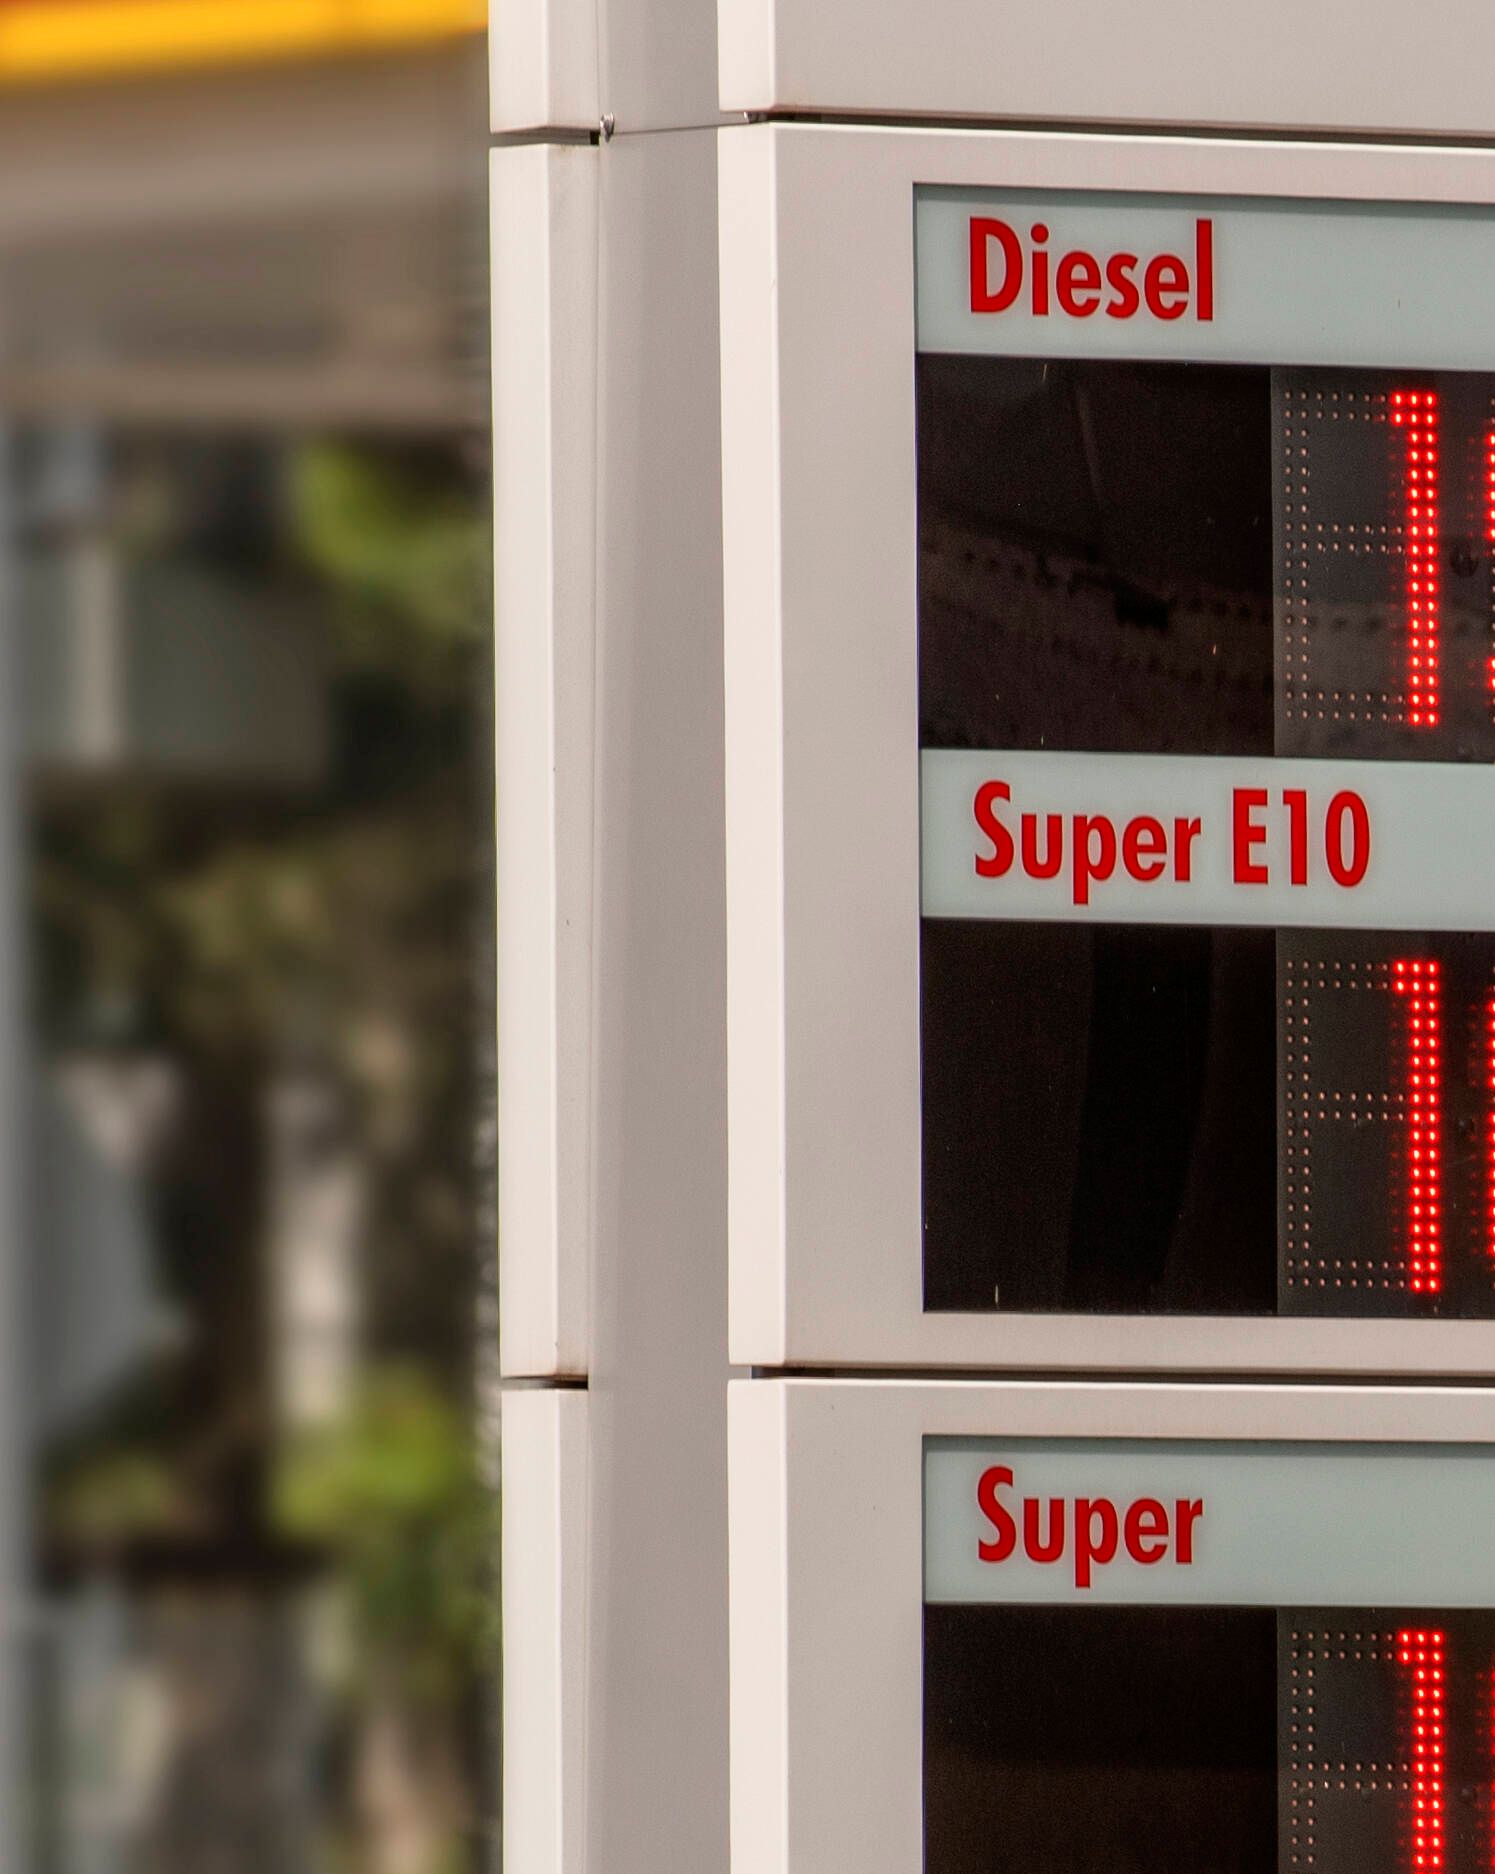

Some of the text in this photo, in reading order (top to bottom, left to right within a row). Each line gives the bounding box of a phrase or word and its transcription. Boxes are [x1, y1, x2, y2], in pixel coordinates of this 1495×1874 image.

[968, 215, 1215, 322] Diesel
[972, 778, 1372, 907] Super E10
[976, 1464, 1205, 1590] Super
